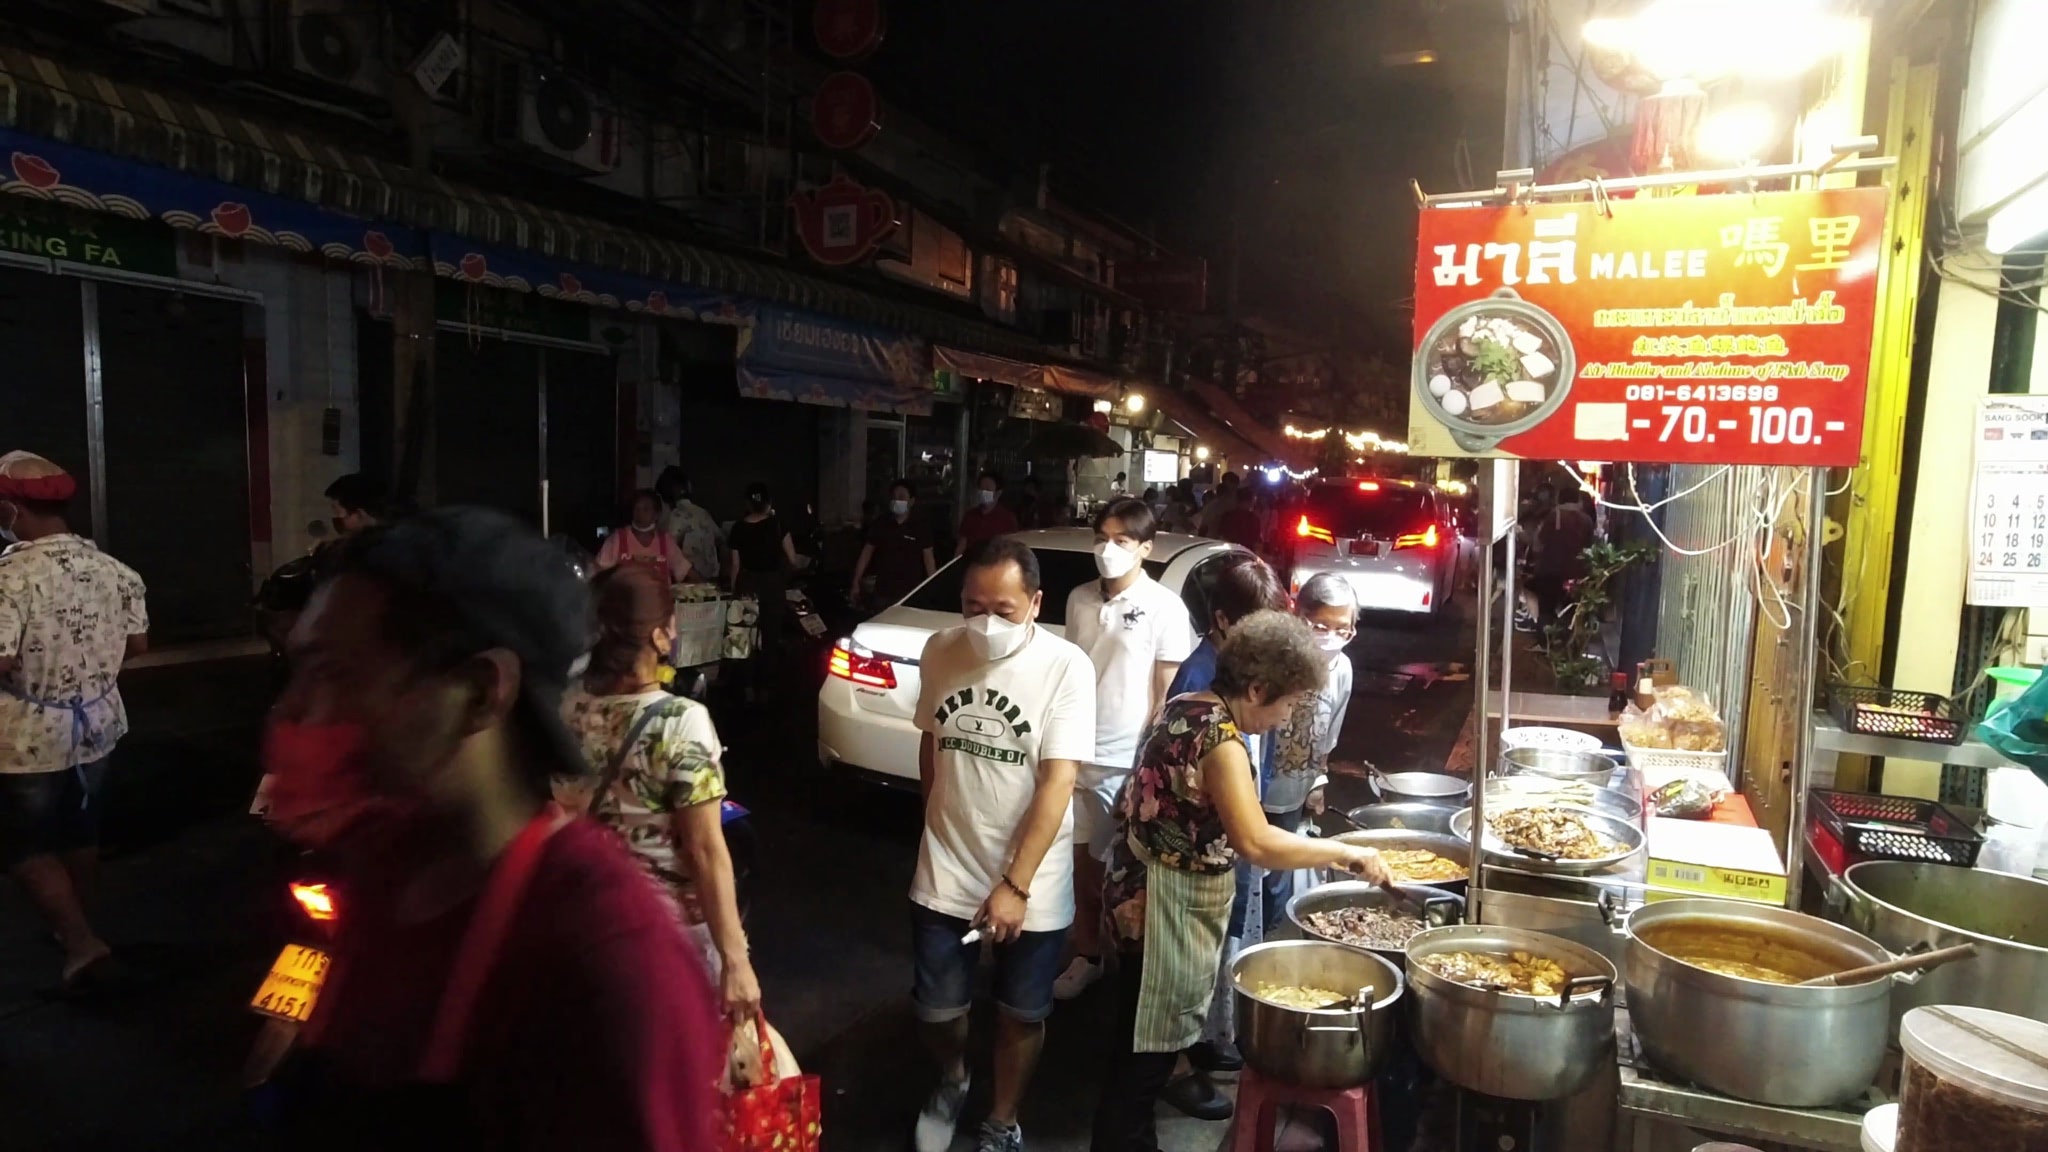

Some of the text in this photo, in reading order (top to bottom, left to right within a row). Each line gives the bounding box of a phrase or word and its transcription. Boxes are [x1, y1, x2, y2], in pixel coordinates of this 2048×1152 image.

[84, 243, 122, 266] FA
[1432, 213, 1578, 286] มาลี
[1590, 250, 1707, 280] MALEE
[1661, 362, 1692, 378] and
[1753, 363, 1773, 381] of
[1771, 362, 1808, 378] Fish
[1808, 362, 1850, 381] Soup
[1626, 384, 1779, 401] 081-6413698
[1987, 494, 2045, 509] 3 4 5
[1983, 513, 2046, 528] 10 11 12
[1981, 532, 2044, 548] 17 18 19
[1979, 552, 2041, 567] 24 25 26
[934, 687, 1032, 738] NEW YORK
[960, 740, 1003, 760] DOUBLE
[259, 992, 308, 1018] 4151
